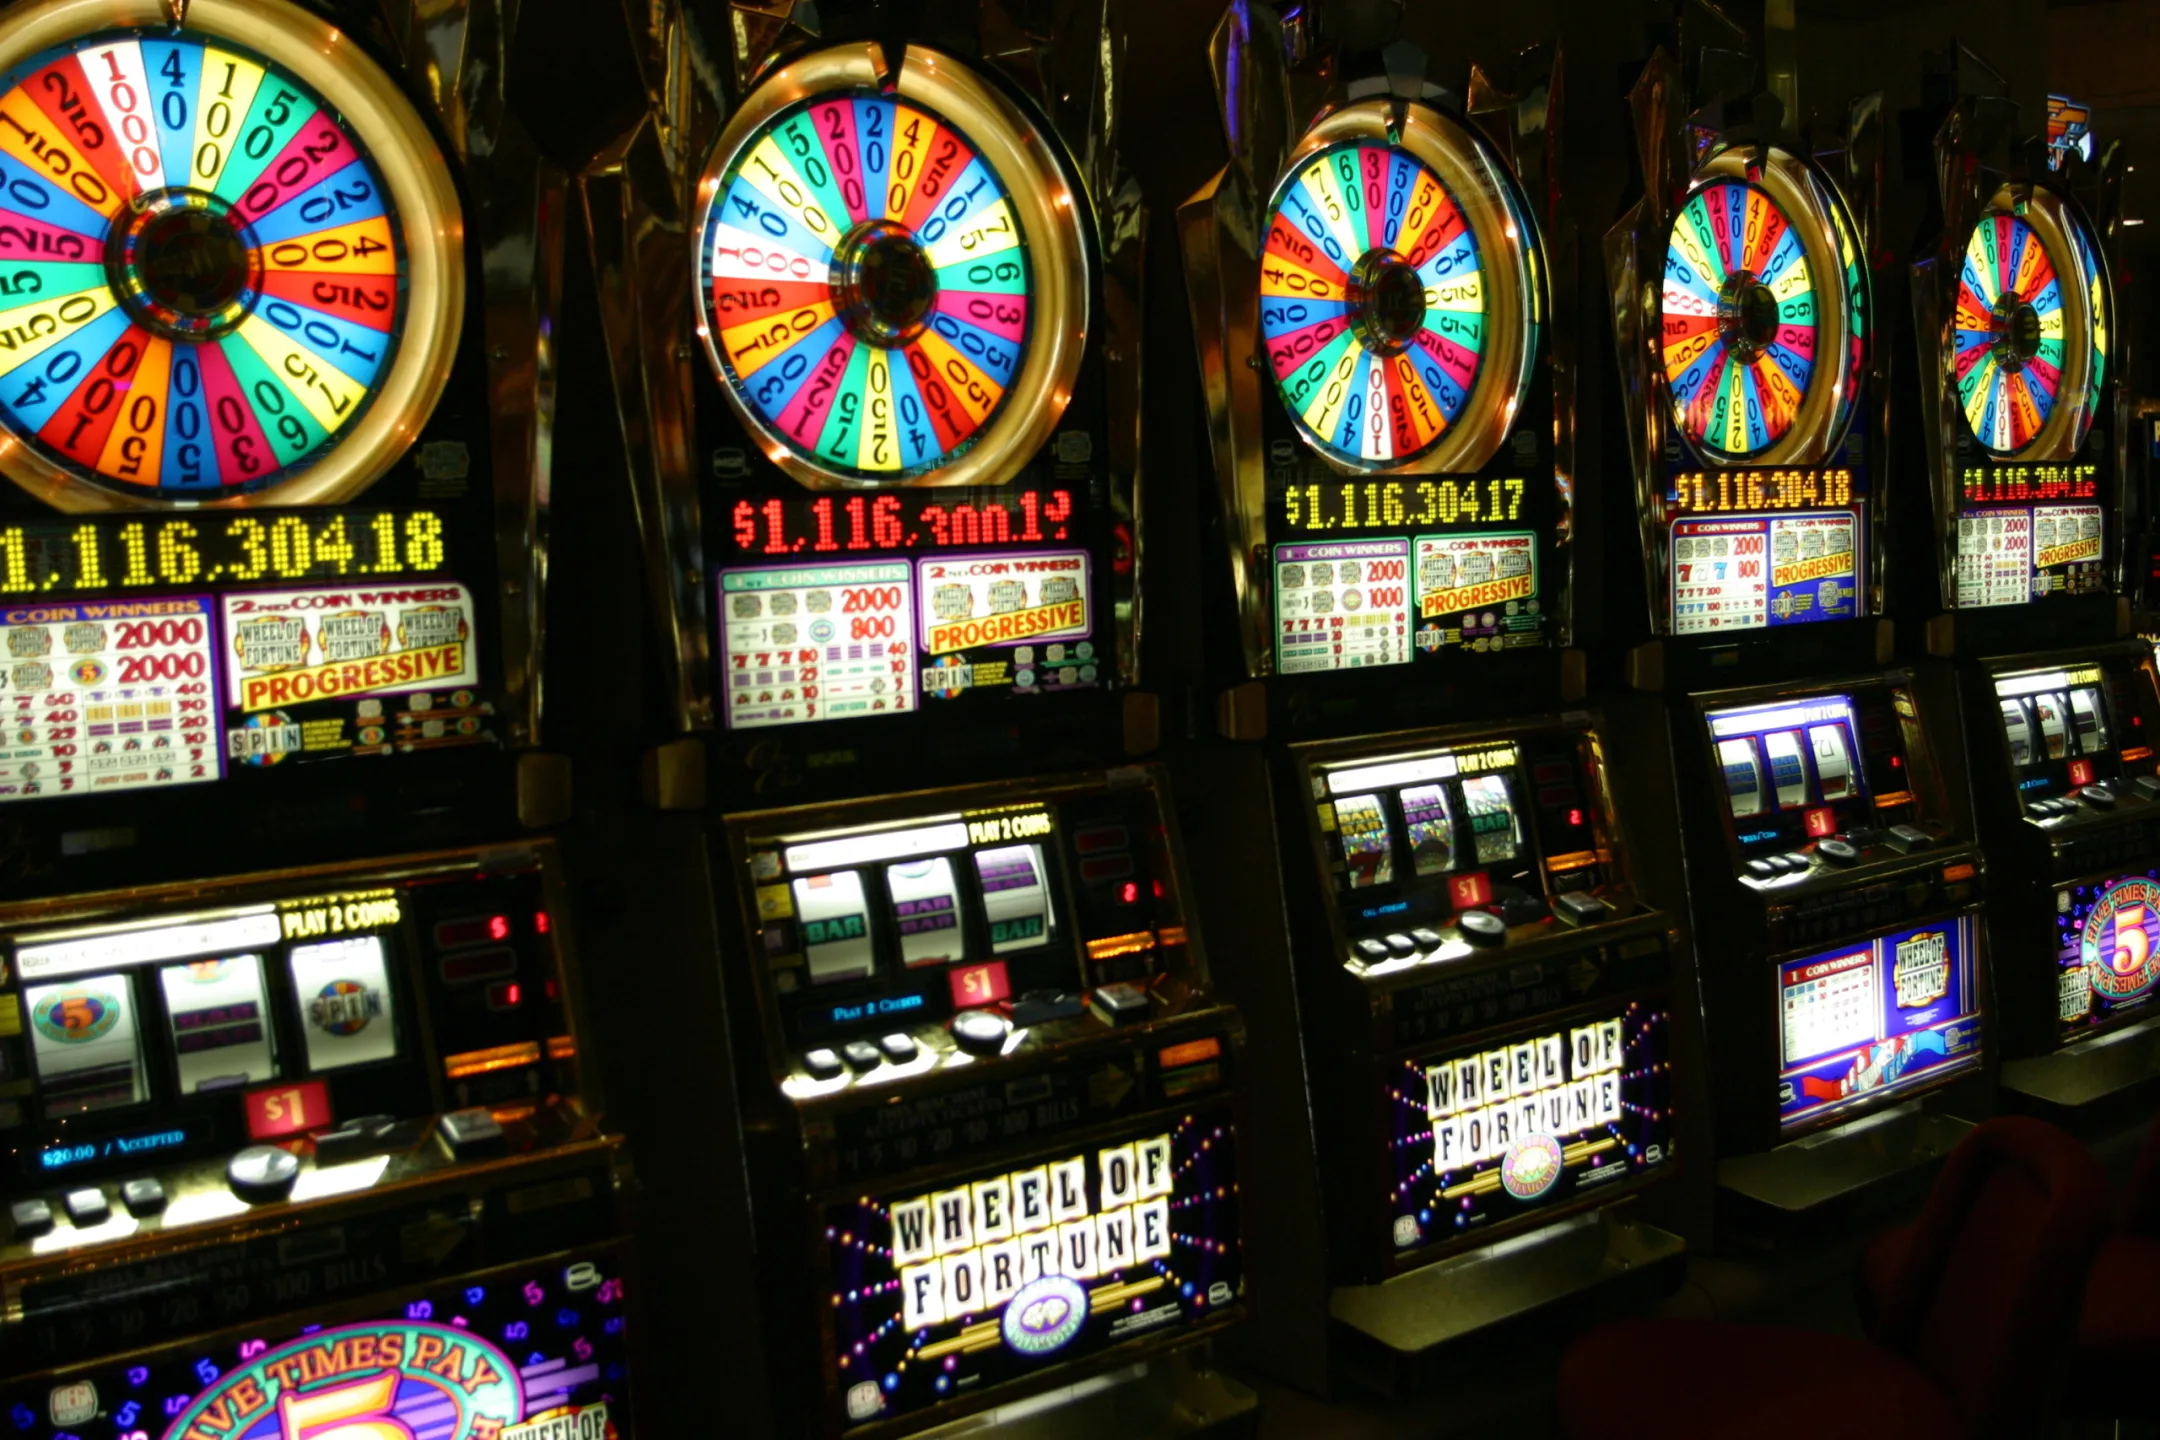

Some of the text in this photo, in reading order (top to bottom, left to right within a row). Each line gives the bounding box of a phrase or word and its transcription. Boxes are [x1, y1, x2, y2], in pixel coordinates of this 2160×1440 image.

[161, 48, 188, 131] 40
[43, 71, 105, 150] 25
[101, 49, 160, 176] 1000
[195, 62, 234, 180] 100
[243, 89, 299, 161] 50
[785, 121, 828, 189] 50
[866, 106, 885, 173] 20
[243, 130, 339, 213] 200
[824, 107, 862, 211] 200
[889, 118, 921, 214] 400
[921, 140, 958, 198] 25
[754, 156, 828, 234] 100
[1338, 154, 1360, 213] 60
[1367, 152, 1382, 210] 30
[299, 180, 371, 225] 20
[730, 195, 789, 238] 40
[922, 177, 987, 243] 100
[1383, 162, 1409, 244] 500
[1408, 182, 1437, 231] 50
[1731, 189, 1741, 238] 20
[960, 215, 1011, 251] 75
[1710, 190, 1732, 265] 200
[1742, 198, 1760, 268] 400
[270, 234, 389, 268] 400
[717, 246, 811, 280] 1000
[1434, 248, 1471, 277] 40
[967, 261, 1021, 285] 60
[312, 280, 390, 312] 25
[719, 287, 781, 313] 25
[967, 299, 1022, 326] 30
[1783, 301, 1811, 318] 60
[265, 301, 377, 365] 100
[733, 309, 818, 361] 150
[935, 315, 1014, 371] 500
[1439, 315, 1479, 341] 75
[12, 350, 83, 409] 40
[63, 340, 138, 452] 100
[284, 352, 352, 416] 75
[756, 354, 808, 405] 30
[795, 347, 848, 440] 125
[910, 349, 963, 438] 100
[946, 358, 992, 412] 50
[1400, 359, 1437, 433] 150
[1424, 367, 1457, 410] 30
[172, 357, 201, 484] 500
[253, 379, 309, 451] 60
[828, 392, 859, 459] 75
[870, 362, 888, 465] 250
[900, 395, 928, 459] 40
[1390, 393, 1413, 450] 25
[1748, 398, 1762, 445] 40
[117, 394, 156, 477] 50
[217, 395, 261, 475] 30
[1286, 480, 1524, 529] $1,116,304.17
[1677, 470, 1849, 511] $1,116,304.18
[1697, 522, 1760, 532] COIN WINNERS
[1796, 520, 1817, 528] COIN
[1996, 508, 2028, 516] WINNERS
[2004, 518, 2028, 532] 2000
[2070, 507, 2099, 515] WINNERS
[1308, 543, 1401, 557] COIN WINNERS
[1450, 539, 1529, 551] COIN WINNERS
[1733, 536, 1763, 555] 2000
[2004, 536, 2028, 550] 2000
[2038, 538, 2098, 565] PROGRESSIVE
[766, 572, 815, 585] COIN
[820, 567, 904, 581] WINNERS
[969, 563, 1009, 576] COIN
[1013, 559, 1080, 572] WINNERS
[1367, 560, 1404, 582] 2000
[1774, 553, 1851, 584] PROGRESSIVE
[6, 600, 200, 624] COIN WINNERS
[291, 594, 352, 610] COIN
[358, 588, 461, 604] WINNERS
[841, 586, 902, 613] 2000
[1369, 586, 1404, 608] 1000
[1425, 577, 1529, 615] PROGRESSIVE
[1772, 600, 1795, 613] SPIN
[114, 618, 203, 649] 2000
[242, 623, 300, 643] WHEEL OF
[324, 617, 381, 637] WHEEL OF
[404, 611, 459, 631] WHEEL OF
[851, 615, 895, 640] 800
[933, 603, 1081, 650] PROGRESSIVE
[1417, 631, 1444, 644] SPIN
[245, 645, 300, 667] FORTUNE
[328, 639, 380, 658] FORTUNE
[116, 652, 205, 683] 2000
[248, 647, 460, 707] PROGRESSIVE
[925, 666, 970, 688] SPIN
[231, 728, 299, 753] SPIN
[1457, 748, 1516, 772] PLAY 2 COINS
[2072, 763, 2085, 781] $1
[968, 812, 1052, 844] PLAY 2 COINS
[1340, 809, 1377, 821] BAR
[1406, 809, 1444, 823] BAR
[1472, 815, 1508, 832] BAR
[1810, 811, 1826, 834] $1
[897, 895, 951, 916] BAR
[1458, 879, 1480, 902] $1
[282, 907, 327, 939] PLAY
[330, 906, 344, 932] 2
[344, 898, 401, 930] COINS
[807, 915, 864, 942] BAR
[901, 915, 954, 934] BAR
[991, 917, 1042, 942] BAR
[2086, 885, 2147, 946] FIVE TIMES
[1899, 936, 1944, 971] WHEEL OF
[2112, 905, 2146, 974] 5
[962, 968, 991, 998] $1
[1806, 964, 1830, 977] COIN
[1830, 954, 1867, 970] WINNERS
[1900, 968, 1942, 1002] FORTUNE
[61, 996, 96, 1031] 5
[310, 989, 382, 1027] SPIN
[1431, 1028, 1615, 1108] WHEEL OF
[265, 1089, 306, 1126] $1
[1442, 1080, 1613, 1160] FORTUNE
[41, 1142, 96, 1169] $20.00
[898, 1145, 1164, 1253] WHEEL OF
[914, 1209, 1161, 1314] FORTUNE
[266, 1331, 502, 1395] TIMES PAY
